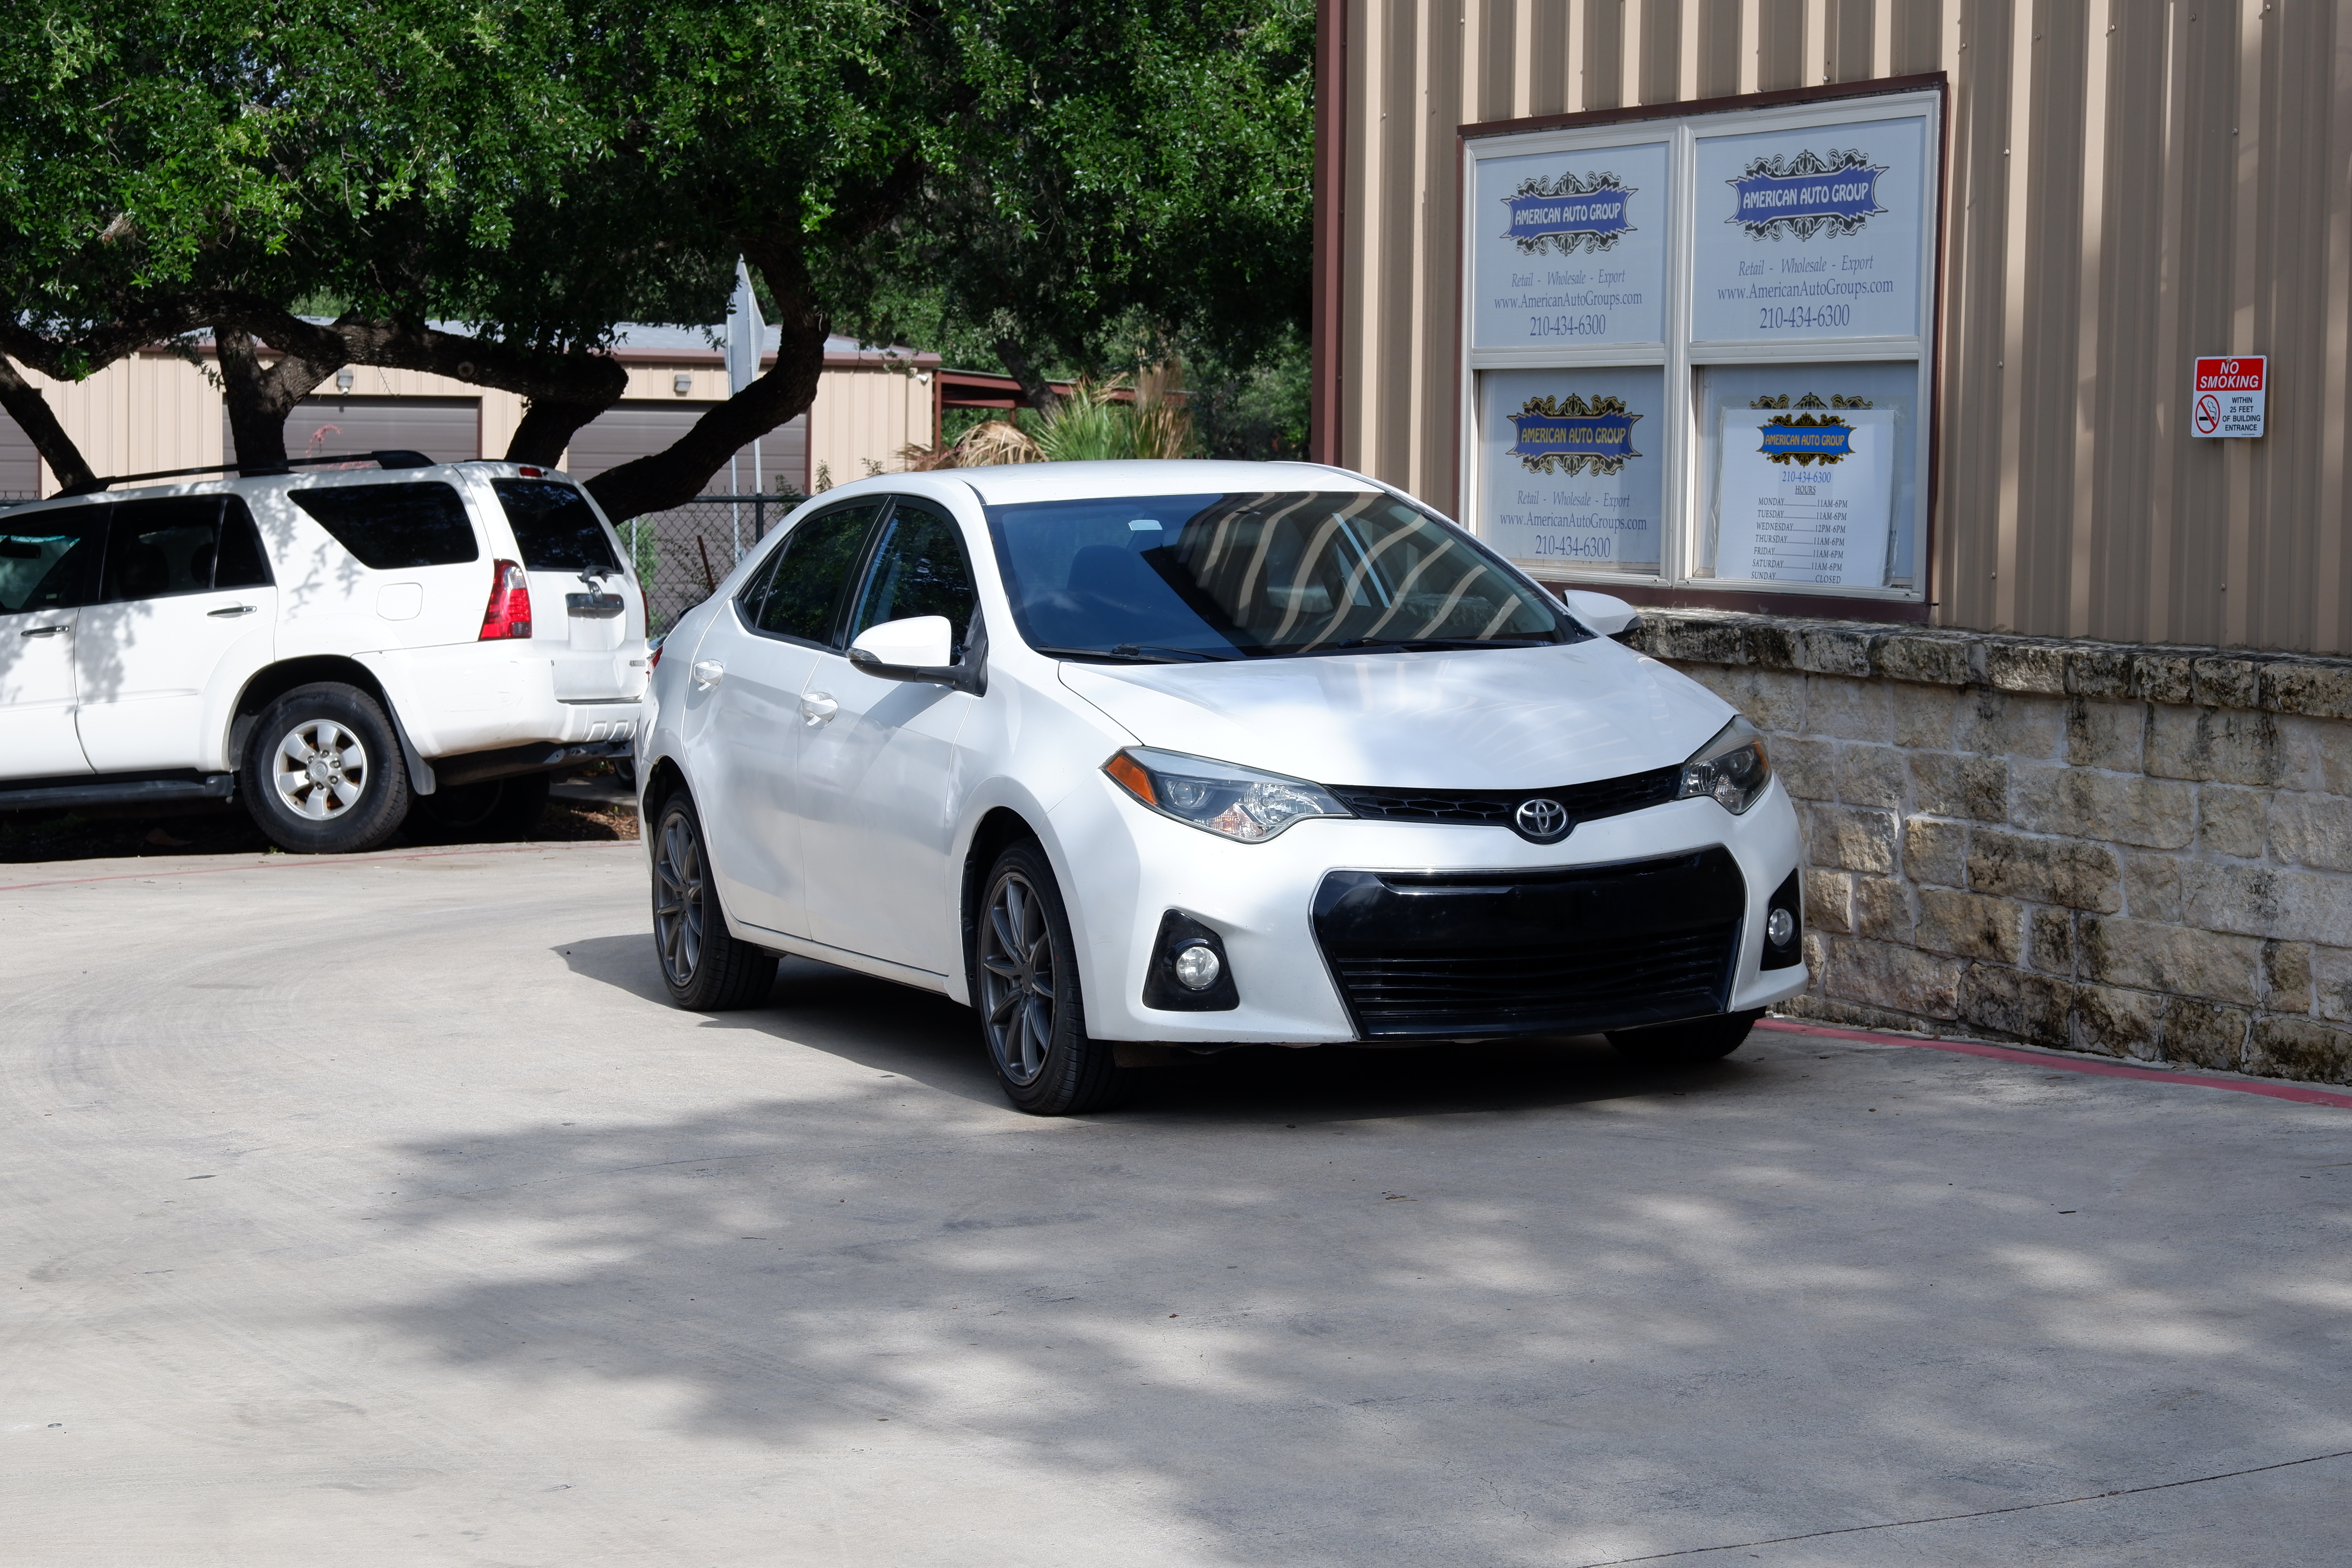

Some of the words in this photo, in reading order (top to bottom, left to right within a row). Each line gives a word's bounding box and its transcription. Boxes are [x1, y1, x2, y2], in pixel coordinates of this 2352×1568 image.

[1743, 189, 1797, 209] AMERICAN
[1800, 186, 1829, 204] AUTO
[1832, 183, 1868, 201] GROUP
[1515, 207, 1560, 225] AMERICAN
[1563, 205, 1587, 222] AUTO
[1590, 203, 1621, 219] GROUP
[1739, 260, 1764, 276] Retail
[1781, 257, 1827, 273] Wholesale
[1842, 255, 1873, 275] Export
[1511, 273, 1533, 287] Retail
[1547, 270, 1585, 285] Wholesale
[1598, 269, 1625, 287] Export
[1718, 279, 1893, 299] www.AmericanAutoGroups.com
[1494, 291, 1642, 309] www.AmericanAutoGroups.com
[1530, 314, 1605, 335] 210-434-6300
[1759, 304, 1849, 328] 210-434-6300
[2220, 362, 2239, 374] NO
[2200, 376, 2258, 388] SMOKING
[1521, 428, 1566, 443] AMERICAN
[1568, 428, 1593, 443] AUTO
[1595, 428, 1626, 443] GROUP
[1765, 435, 1799, 445] AMERICAN
[1801, 435, 1819, 445] AUTO
[1821, 435, 1844, 445] GROUP
[1782, 471, 1831, 482] 210-434-6300
[1795, 485, 1816, 494] HOURS
[1517, 491, 1539, 505] Retail
[1553, 492, 1591, 506] Wholesale
[1603, 493, 1630, 511] Export
[1500, 513, 1646, 533] www.AmericanAutoGroups.com
[1535, 535, 1610, 557] 210-434-6300
